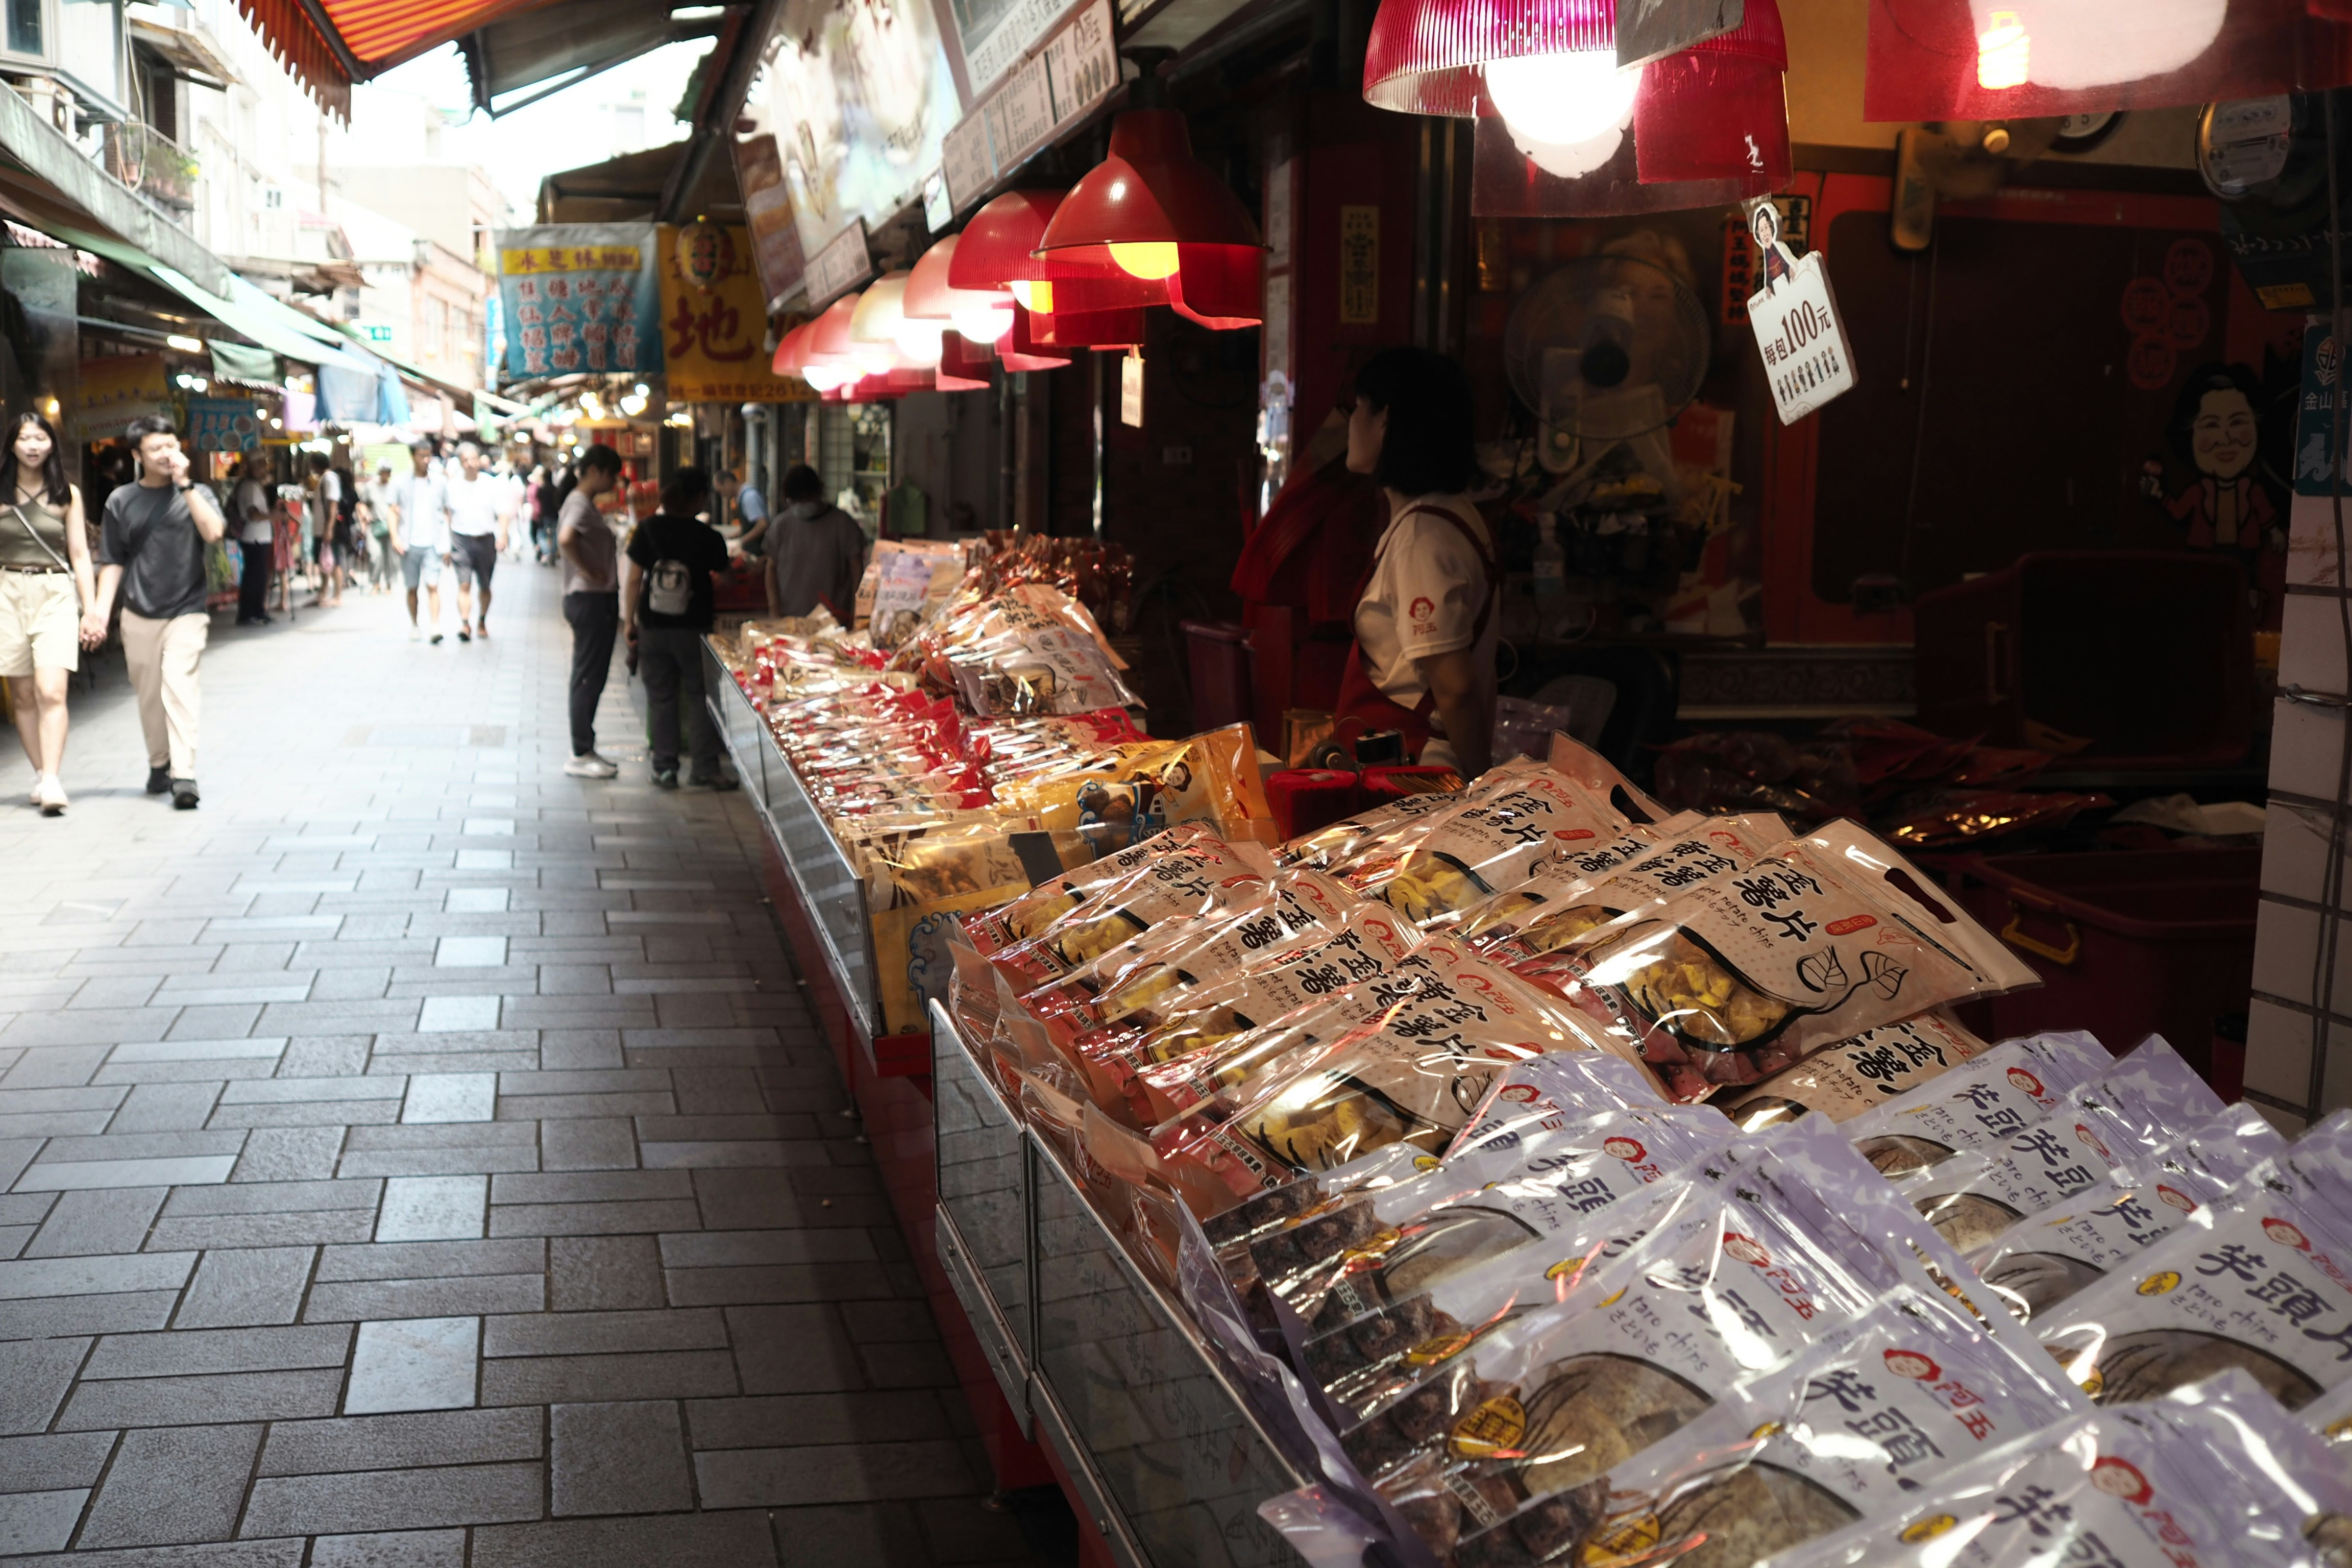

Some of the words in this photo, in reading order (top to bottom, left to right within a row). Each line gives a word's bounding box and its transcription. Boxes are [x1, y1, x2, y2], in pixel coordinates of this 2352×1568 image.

[668, 296, 809, 360] 地
[1765, 300, 1831, 366] 每包100元
[1548, 788, 1576, 808] 阿玉
[1468, 826, 1490, 840] potato
[1490, 839, 1507, 852] chip
[1161, 892, 1181, 909] chips
[1718, 892, 1749, 923] potato
[1749, 924, 1775, 949] chips
[1326, 928, 1389, 982] 黃金
[1416, 981, 1489, 1023] 黃金
[1485, 990, 1520, 1016] 阿玉
[1373, 1036, 1400, 1052] potato
[1834, 1066, 1864, 1097] potato
[1915, 1112, 1954, 1142] さといも
[1930, 1106, 1955, 1125] taro
[2057, 1226, 2106, 1264] さといも
[2075, 1219, 2106, 1244] taro
[1766, 1268, 1821, 1321] 阿玉
[2170, 1294, 2228, 1332] さといも
[2186, 1283, 2224, 1310] taro
[2228, 1309, 2280, 1343] chips
[1609, 1308, 1661, 1357] さといも
[1628, 1295, 1662, 1329] taro
[1664, 1330, 1709, 1374] chips
[1805, 1369, 1946, 1492] 芋頭
[1933, 1380, 1997, 1442] 阿玉
